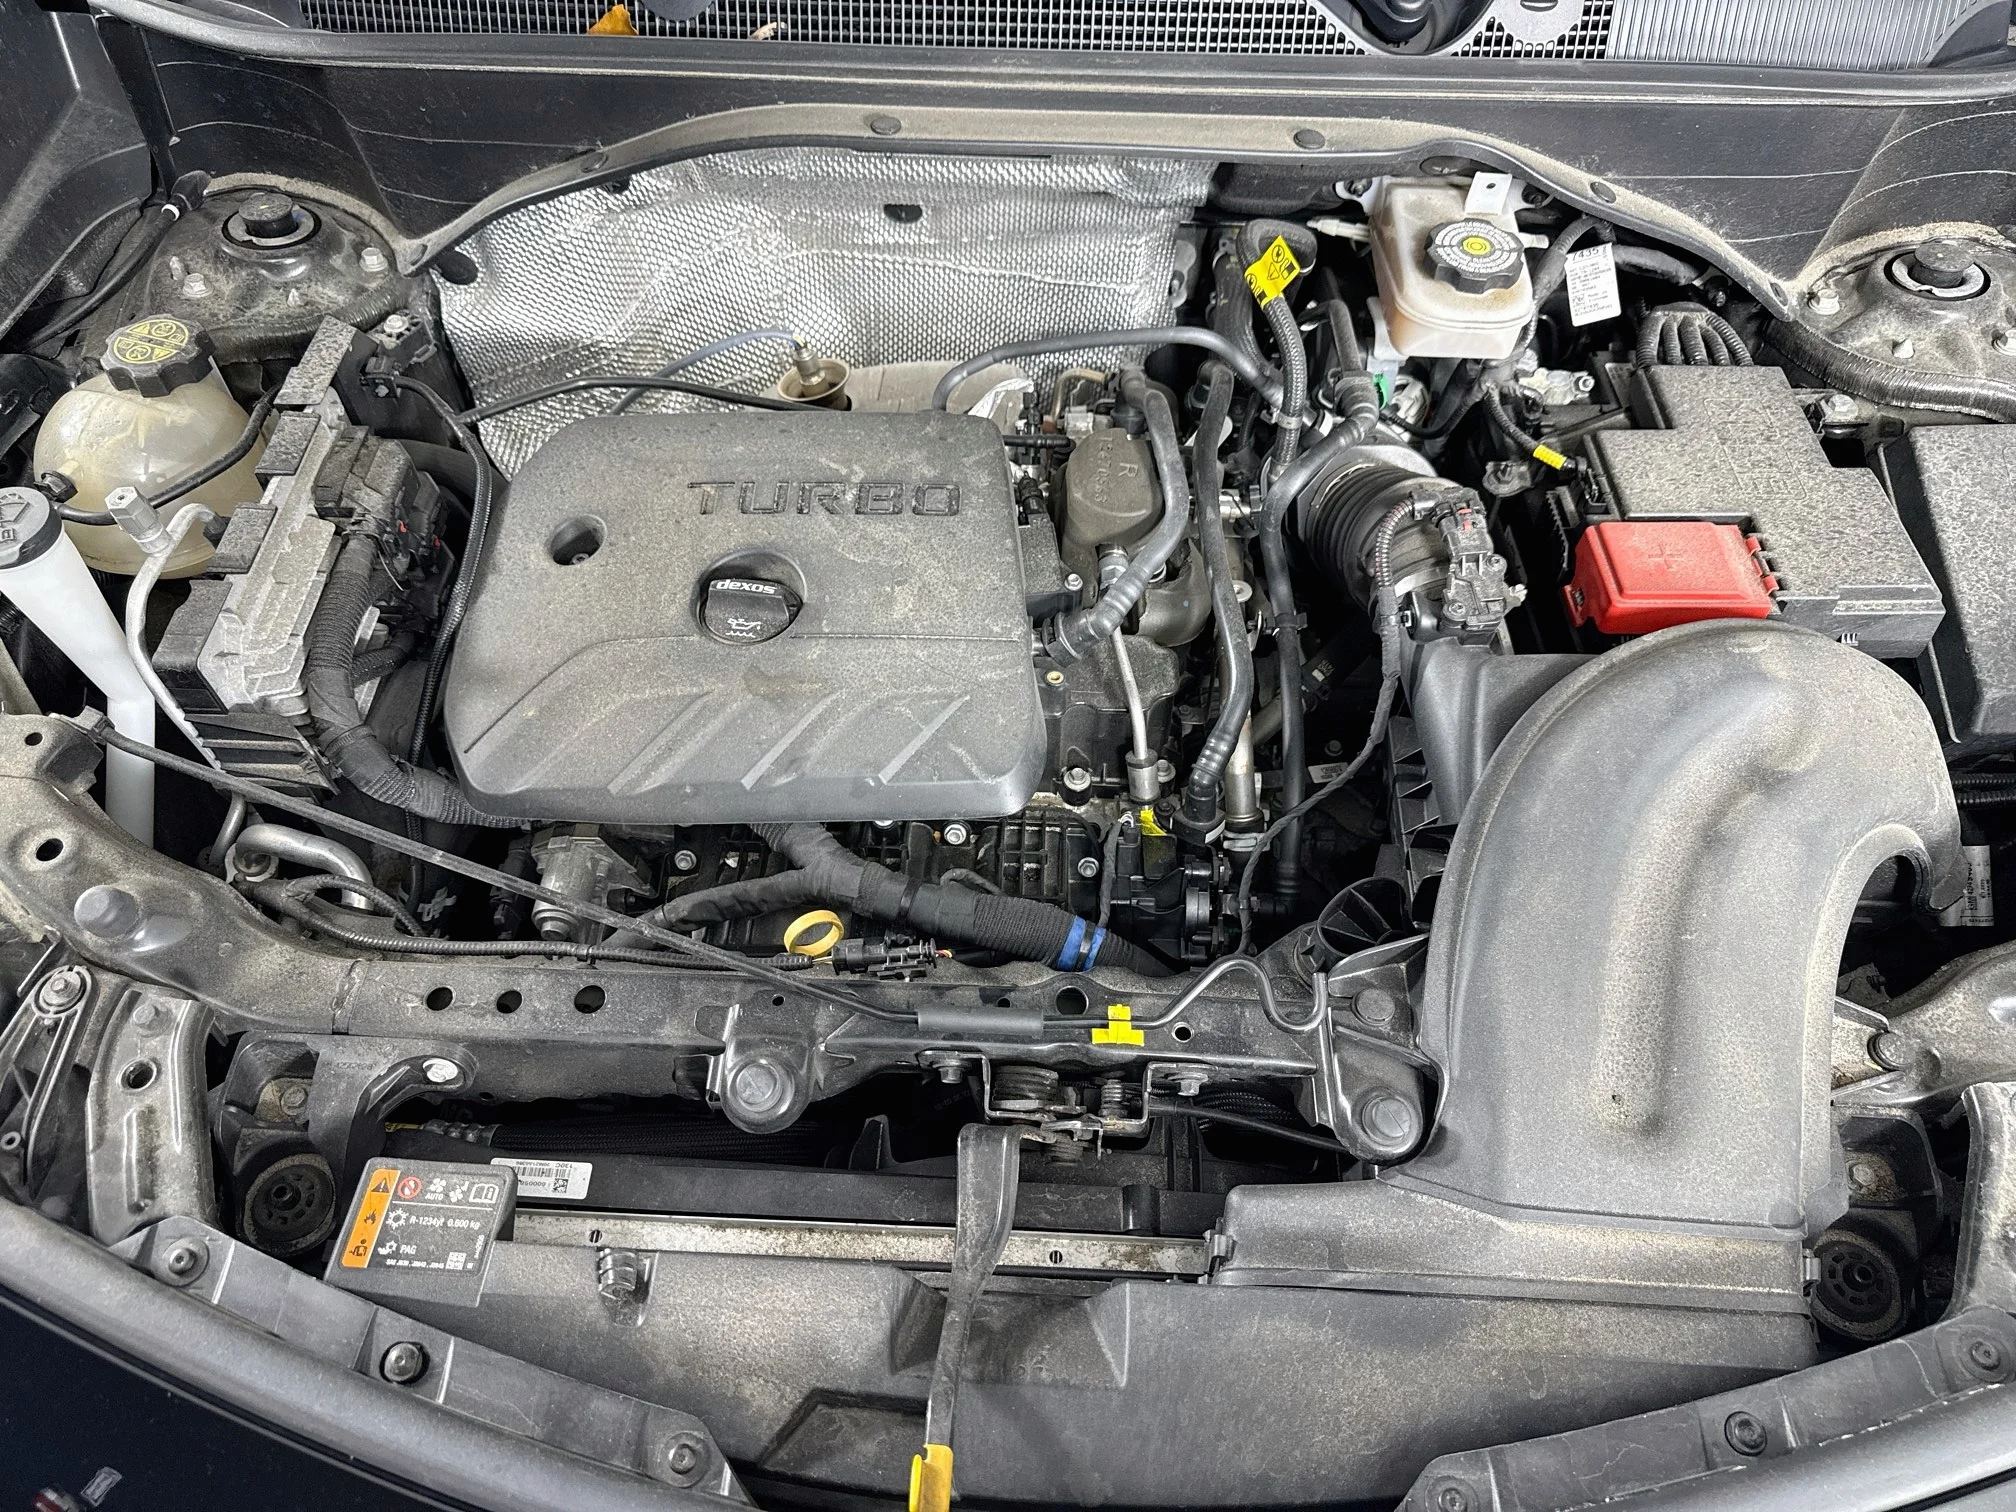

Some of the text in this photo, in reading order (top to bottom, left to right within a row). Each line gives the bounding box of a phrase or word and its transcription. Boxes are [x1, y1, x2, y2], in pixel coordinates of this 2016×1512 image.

[1119, 462, 1138, 477] R
[687, 481, 961, 516] TURBO
[716, 579, 777, 595] dexos
[424, 1192, 444, 1201] AUTO
[447, 1218, 469, 1229] 0.600
[470, 1220, 481, 1231] kg
[400, 1244, 417, 1255] PAG
